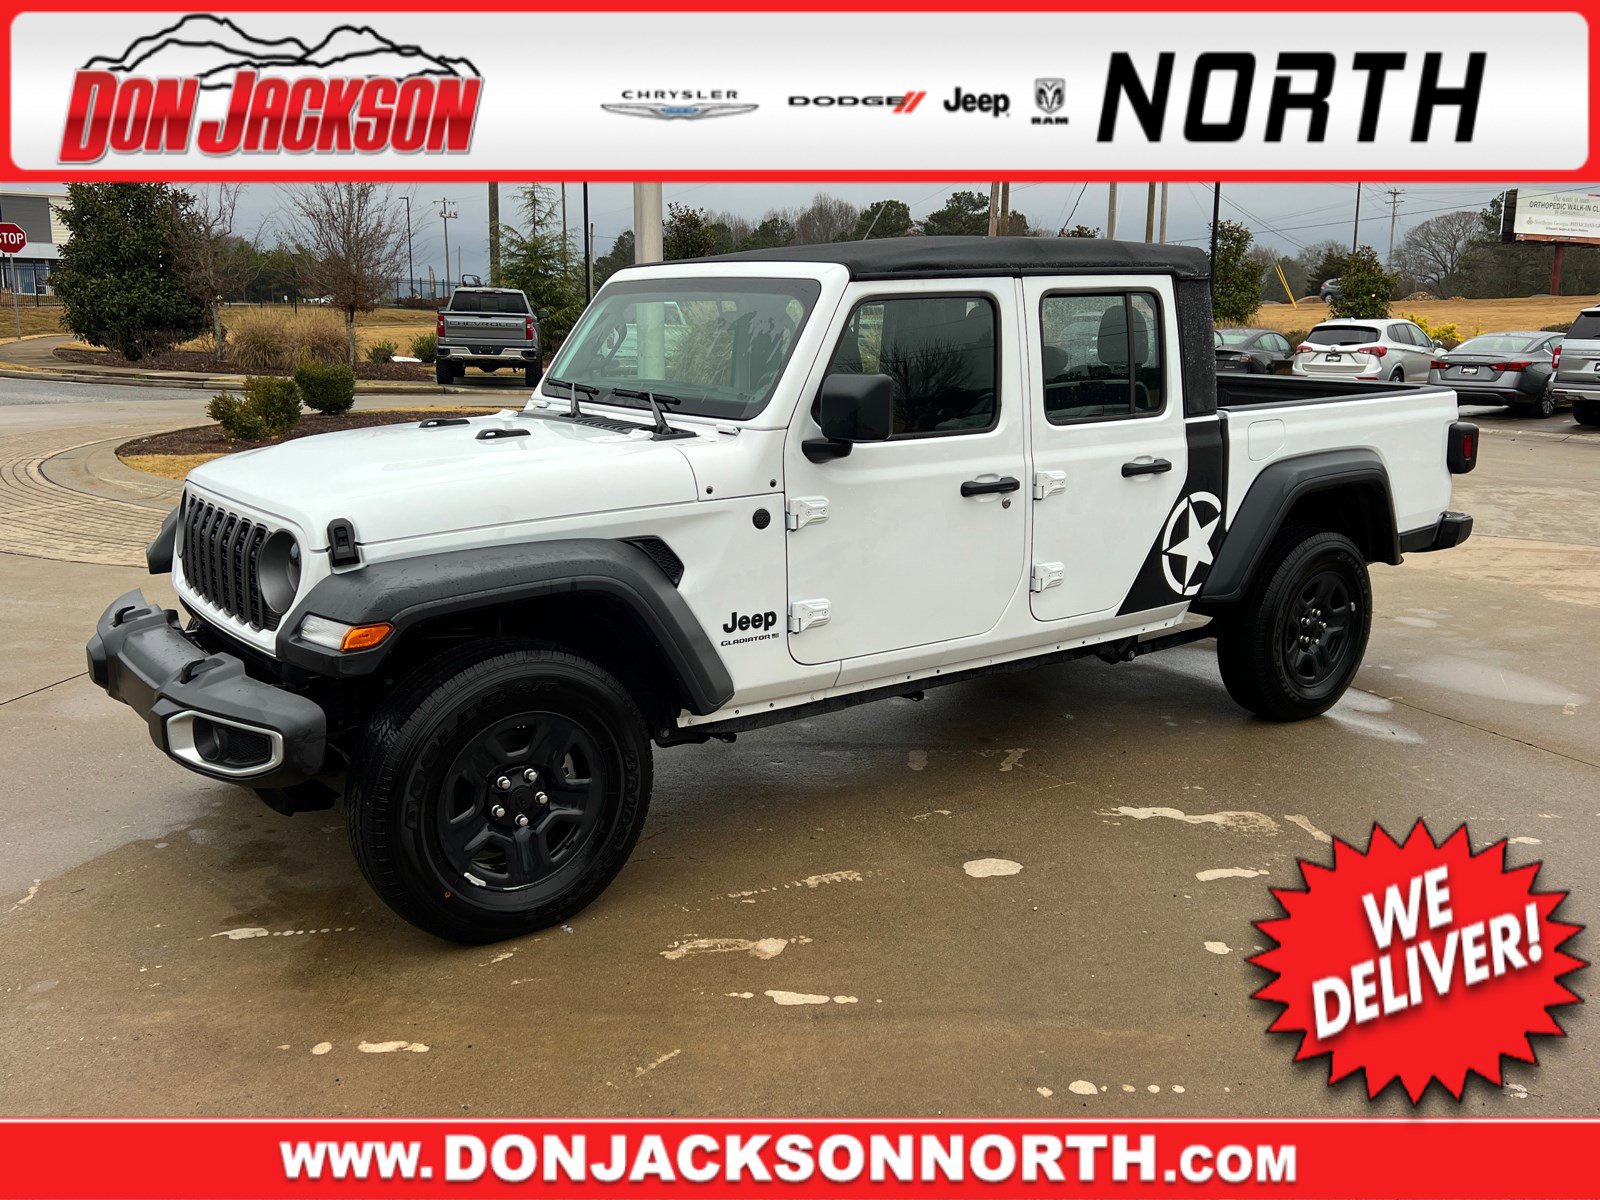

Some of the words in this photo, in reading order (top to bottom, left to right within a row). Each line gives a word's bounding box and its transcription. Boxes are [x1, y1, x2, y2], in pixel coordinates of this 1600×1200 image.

[1529, 201, 1567, 210] ORTHOPEDIC
[1567, 203, 1592, 212] WALK-IN
[1592, 205, 1600, 213] CL
[722, 611, 777, 634] Jeep
[720, 634, 771, 647] GLADIATOR
